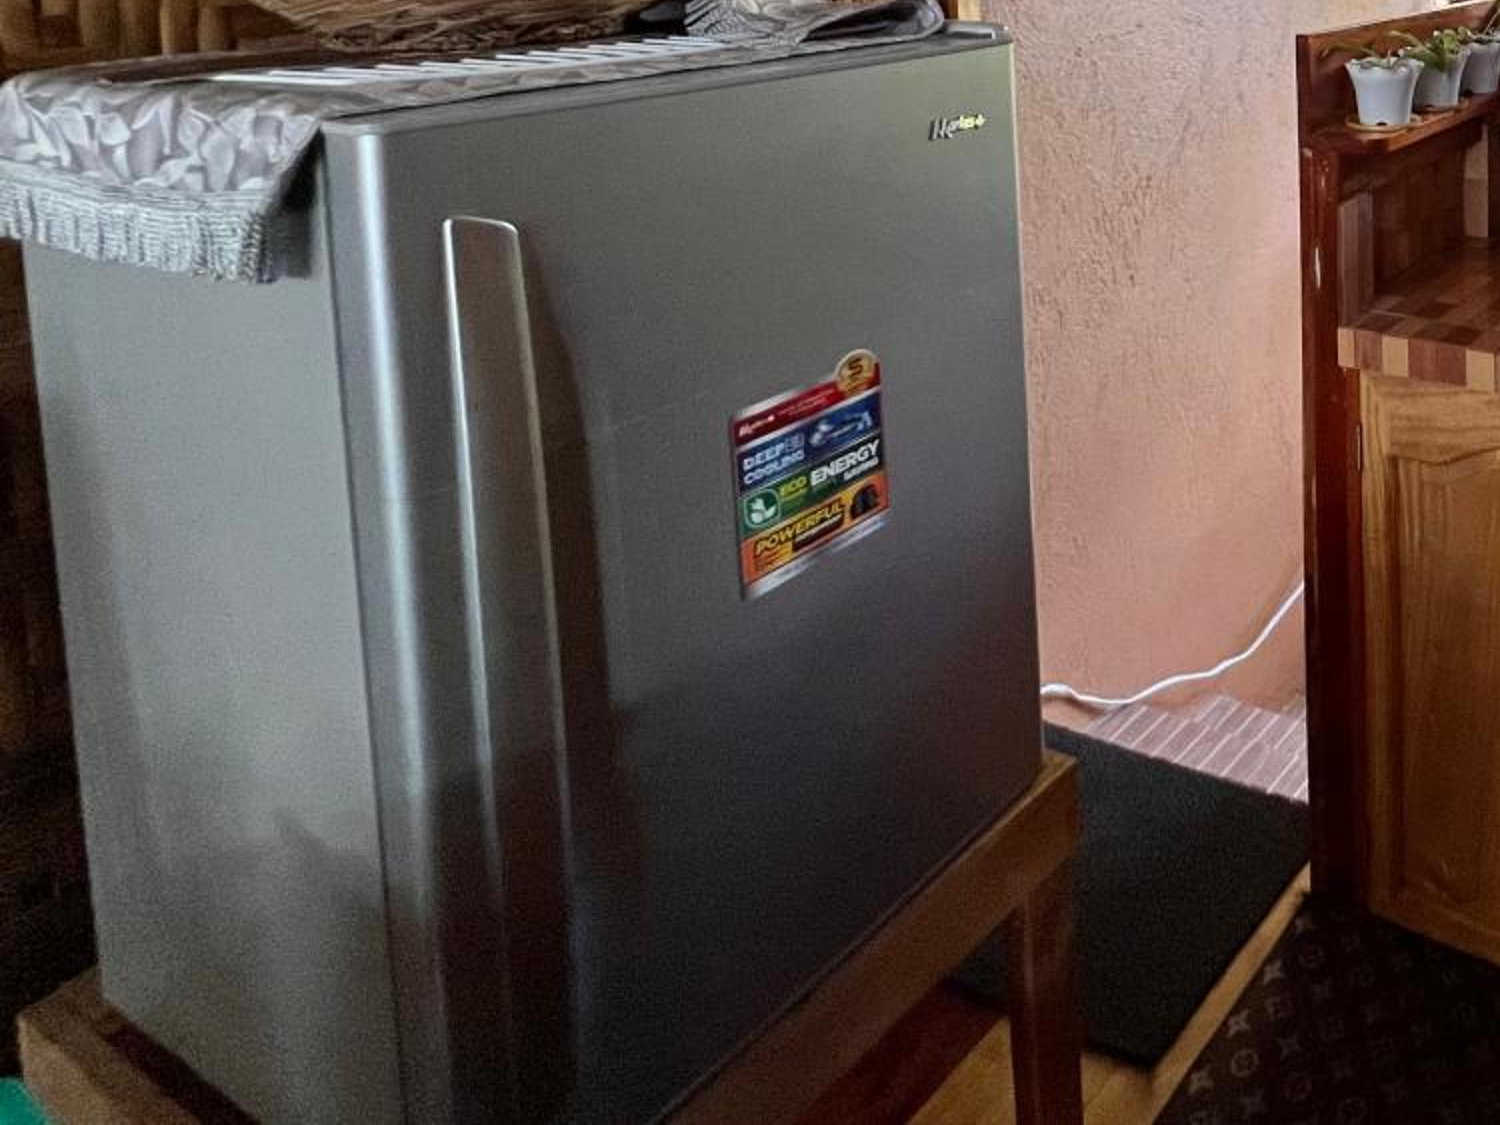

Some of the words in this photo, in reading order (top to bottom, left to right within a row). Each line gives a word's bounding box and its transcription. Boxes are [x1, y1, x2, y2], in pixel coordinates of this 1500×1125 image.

[743, 442, 785, 471] DEEP
[744, 450, 805, 484] COOLING
[779, 476, 808, 496] ECO
[811, 439, 880, 486] ENERGY
[756, 503, 844, 555] POWERFUL
